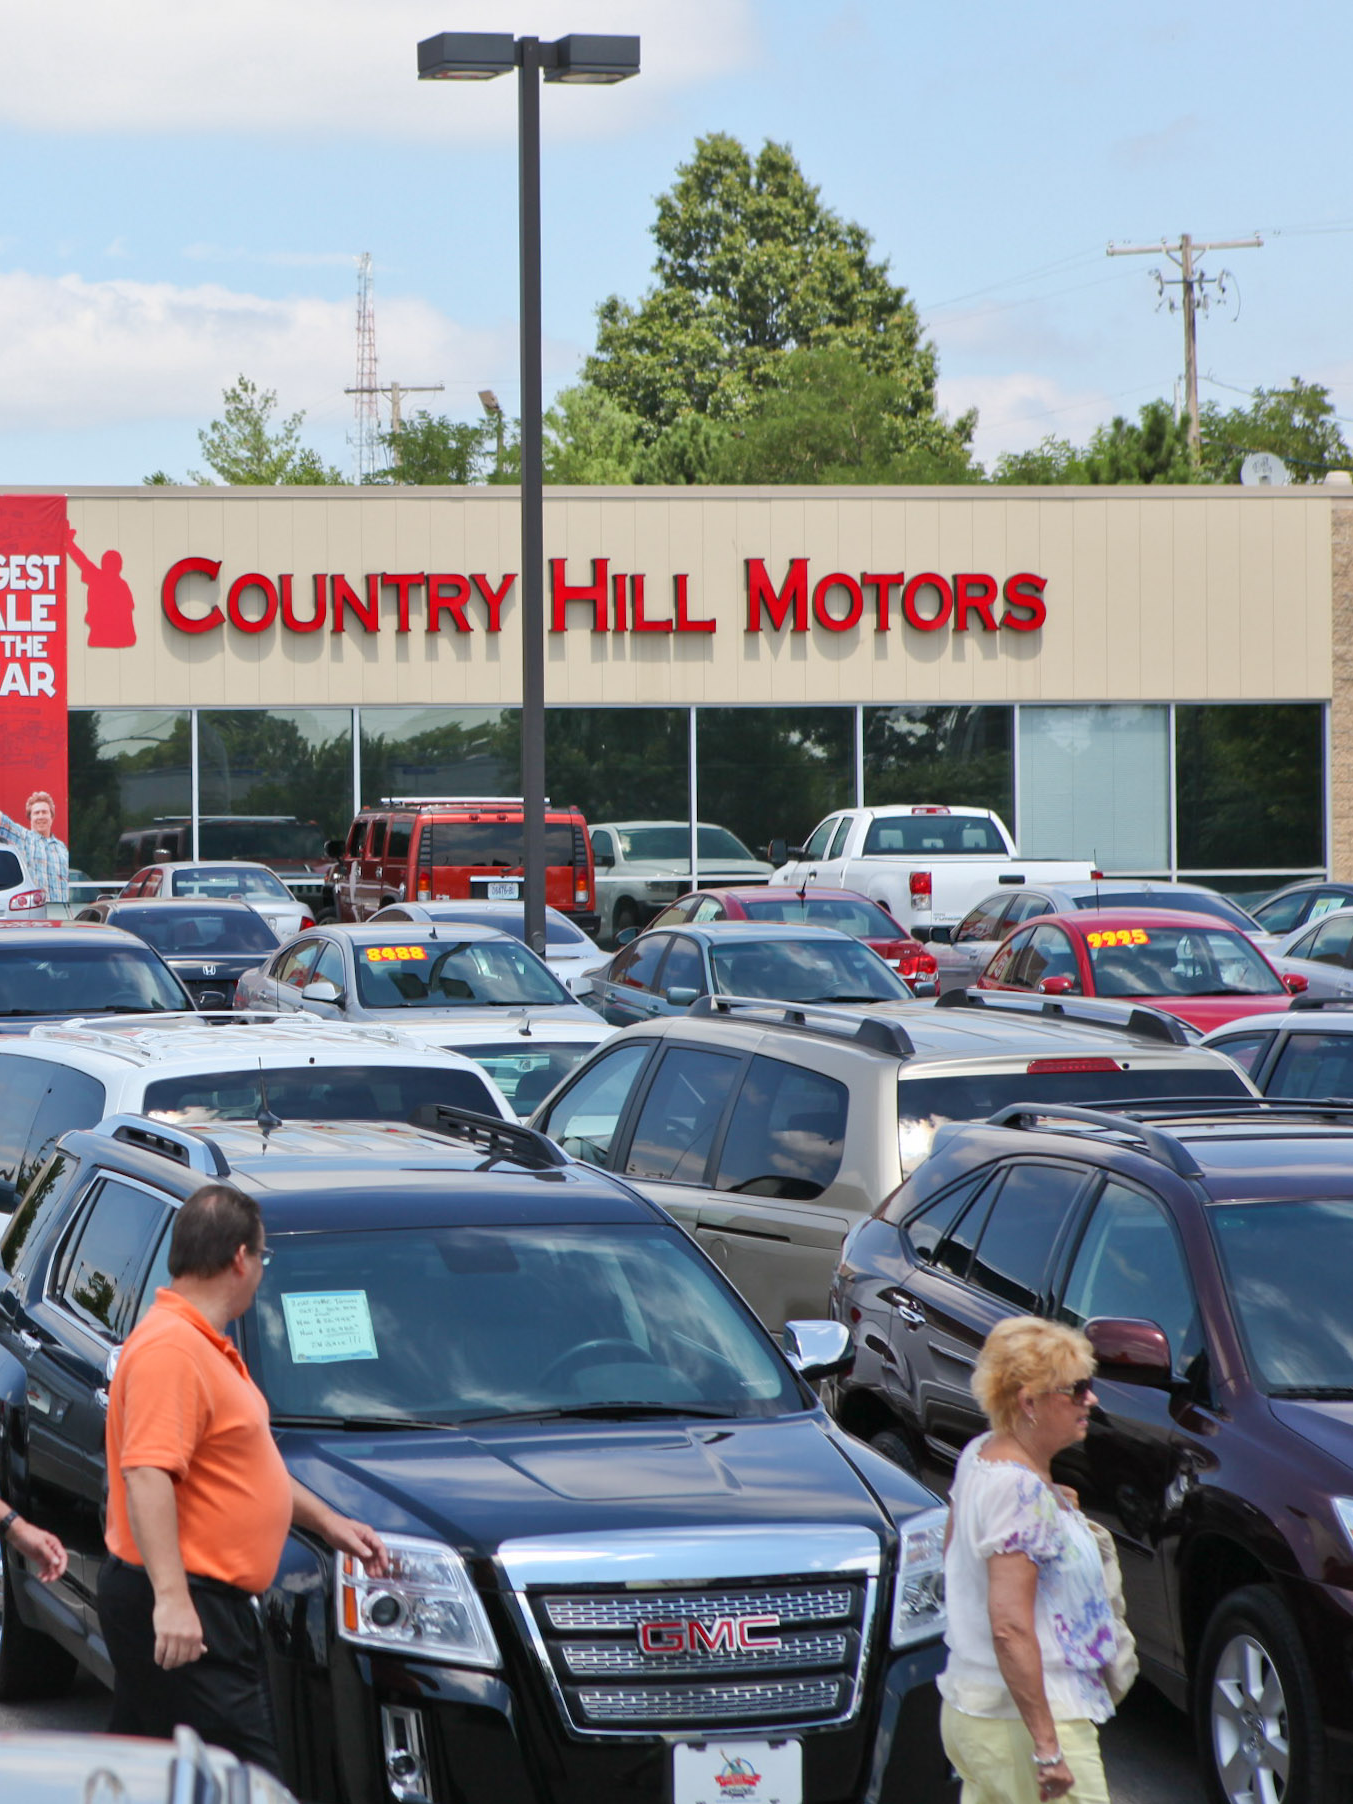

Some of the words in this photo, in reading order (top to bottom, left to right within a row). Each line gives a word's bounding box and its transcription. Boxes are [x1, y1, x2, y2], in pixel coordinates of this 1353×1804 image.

[161, 556, 519, 633] COUNTRY
[547, 558, 717, 634] HILL
[745, 558, 1048, 633] MOTORS
[0, 635, 47, 658] THE
[1087, 928, 1148, 948] 9995
[637, 1614, 783, 1655] GMC
